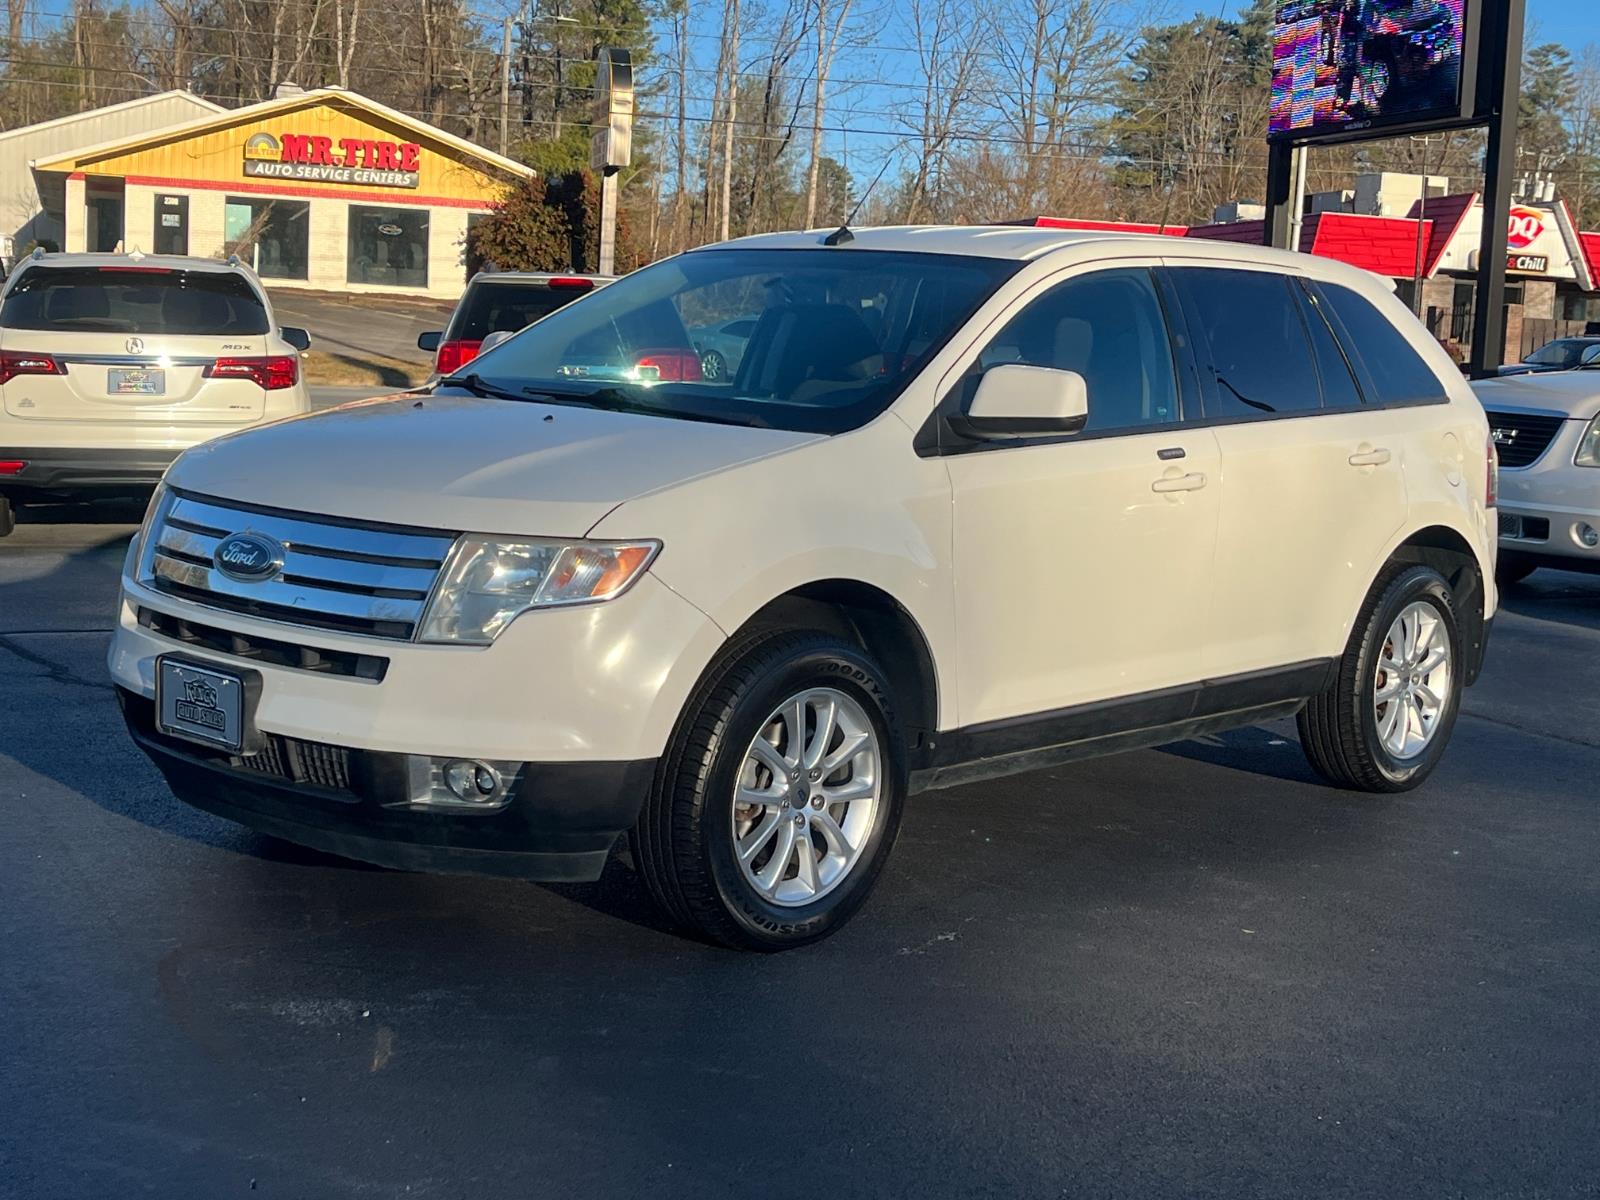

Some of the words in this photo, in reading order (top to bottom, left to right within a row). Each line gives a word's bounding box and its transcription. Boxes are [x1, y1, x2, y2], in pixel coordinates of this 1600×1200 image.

[340, 139, 420, 172] TIRE
[255, 163, 293, 176] AUTO
[296, 166, 350, 180] SERVICE
[353, 170, 411, 185] CENTERS
[1508, 215, 1538, 240] DQ
[1516, 256, 1546, 271] Chill
[222, 541, 259, 566] Ford
